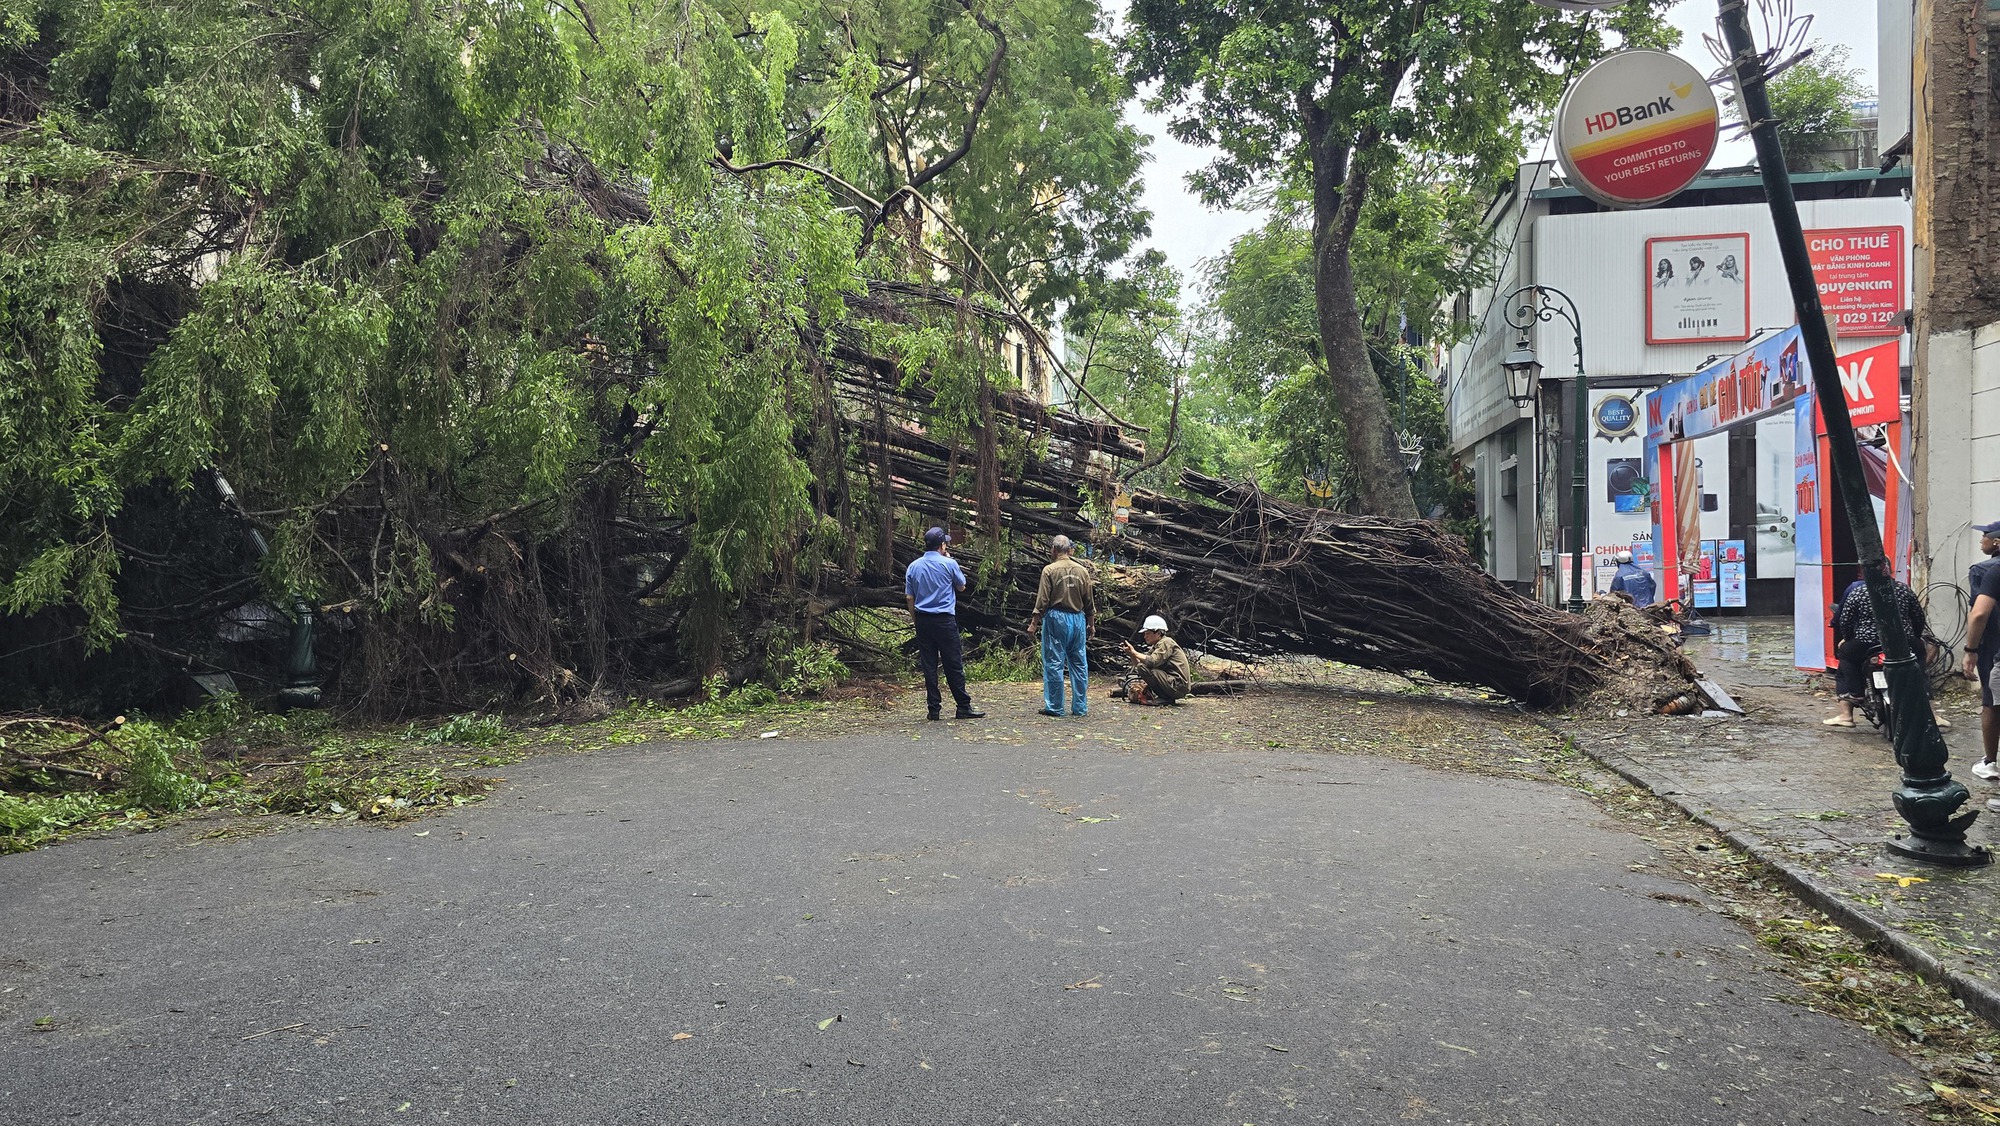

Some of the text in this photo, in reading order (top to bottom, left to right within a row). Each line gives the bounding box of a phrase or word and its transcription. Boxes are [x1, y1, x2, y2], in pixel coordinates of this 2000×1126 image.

[1584, 96, 1675, 135] HDBank
[1604, 150, 1702, 183] YOUR BEST RETURNS
[1613, 140, 1686, 167] COMMITTED TO
[1810, 233, 1890, 252] CHO THUÊ
[1843, 312, 1867, 324] 029
[1718, 361, 1738, 424] GIÁ
[1739, 351, 1763, 415] TỐT
[1796, 473, 1815, 514] TỐT
[1595, 543, 1633, 554] CHÍNH
[1632, 531, 1653, 541] SẢN
